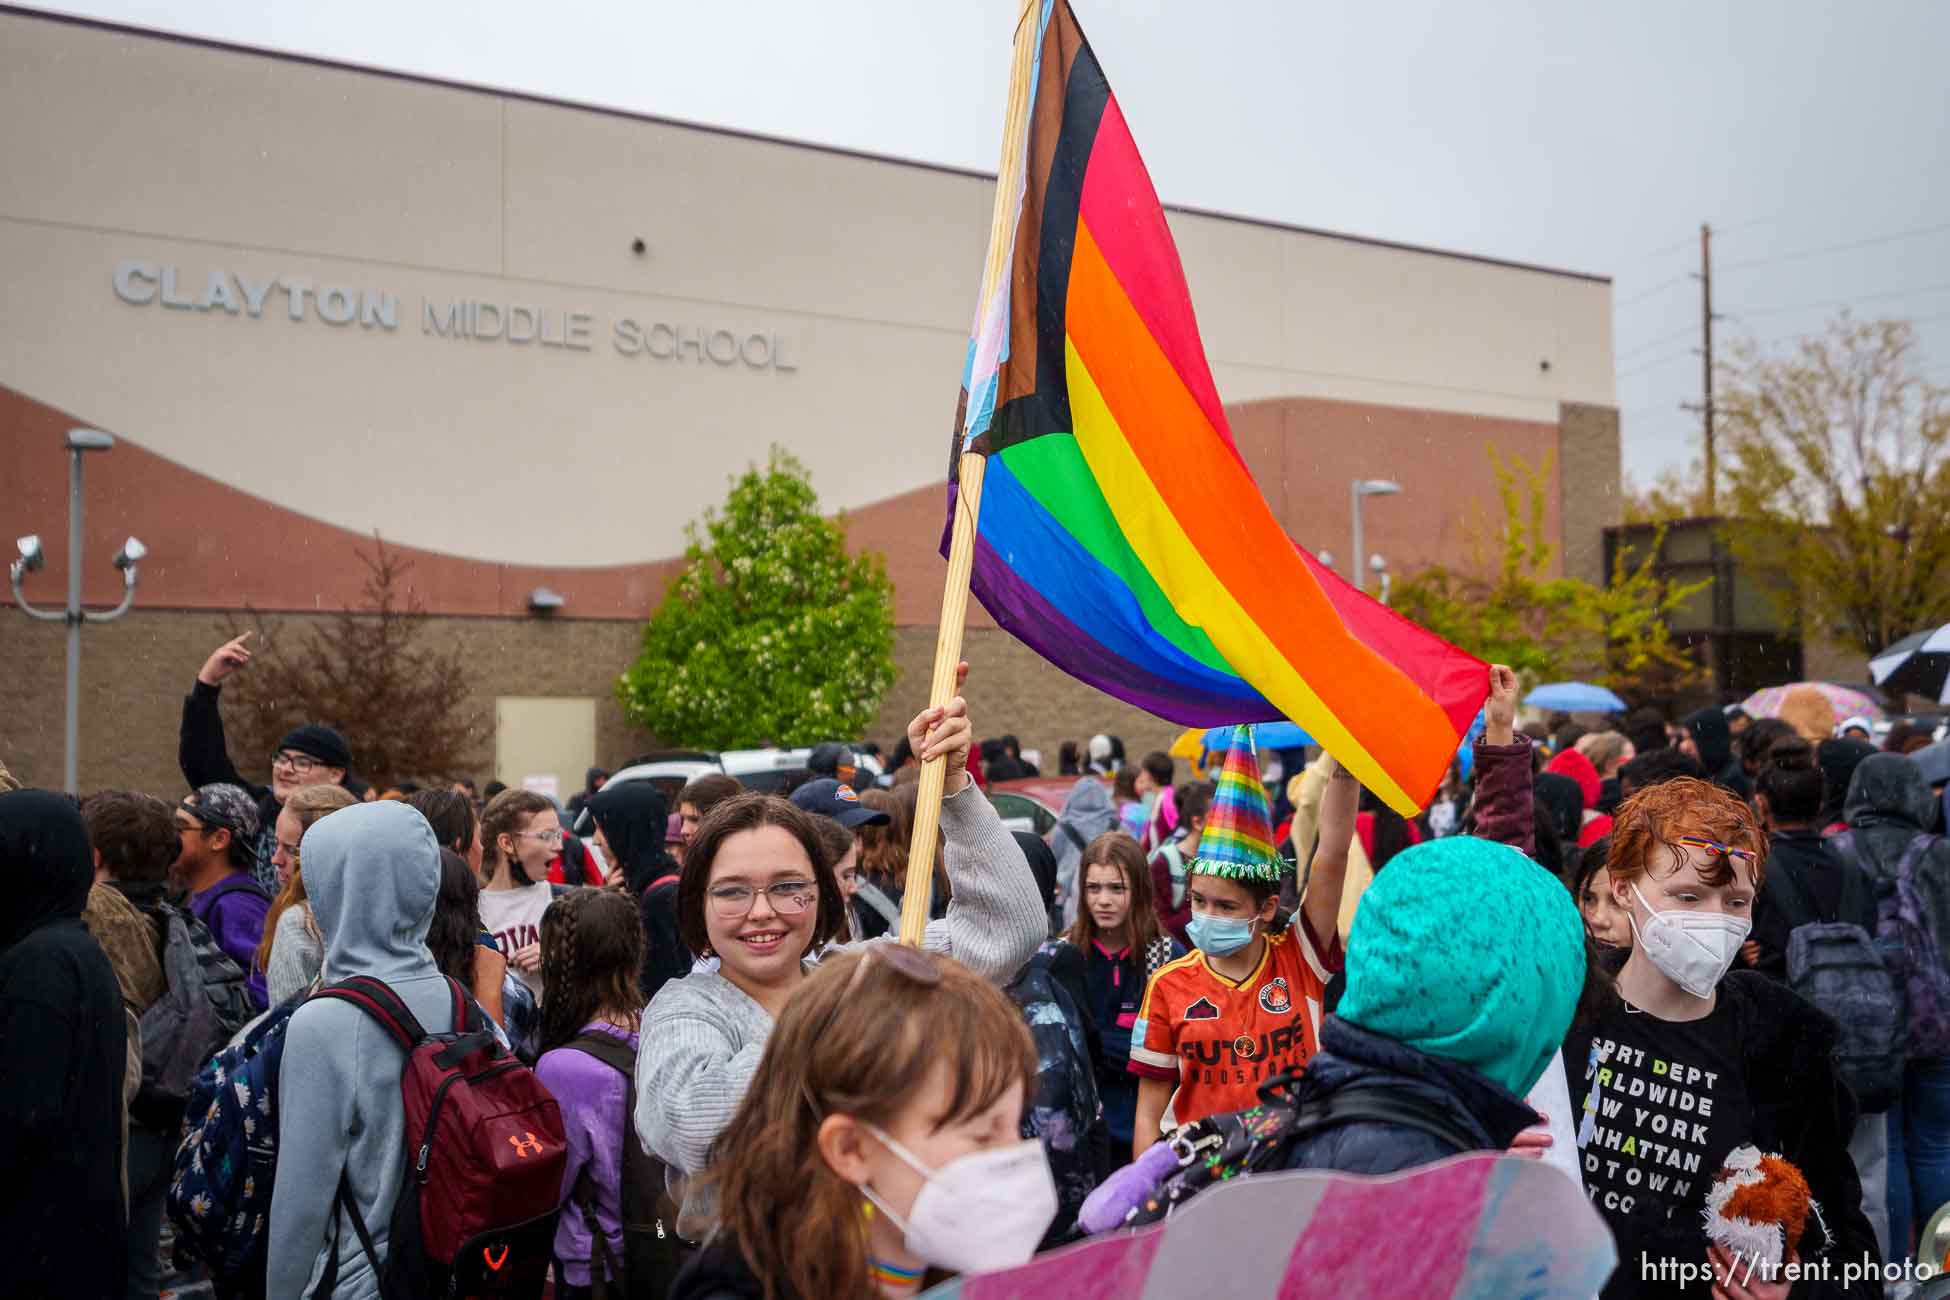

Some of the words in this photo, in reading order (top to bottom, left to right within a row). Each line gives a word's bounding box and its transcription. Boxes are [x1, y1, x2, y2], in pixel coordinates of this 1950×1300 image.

[112, 260, 398, 330] CLAYTON
[421, 297, 592, 351] MIDDLE
[614, 319, 797, 373] SCHOOL
[1653, 1059, 1718, 1090] DEPT
[1635, 1108, 1709, 1145] YORK
